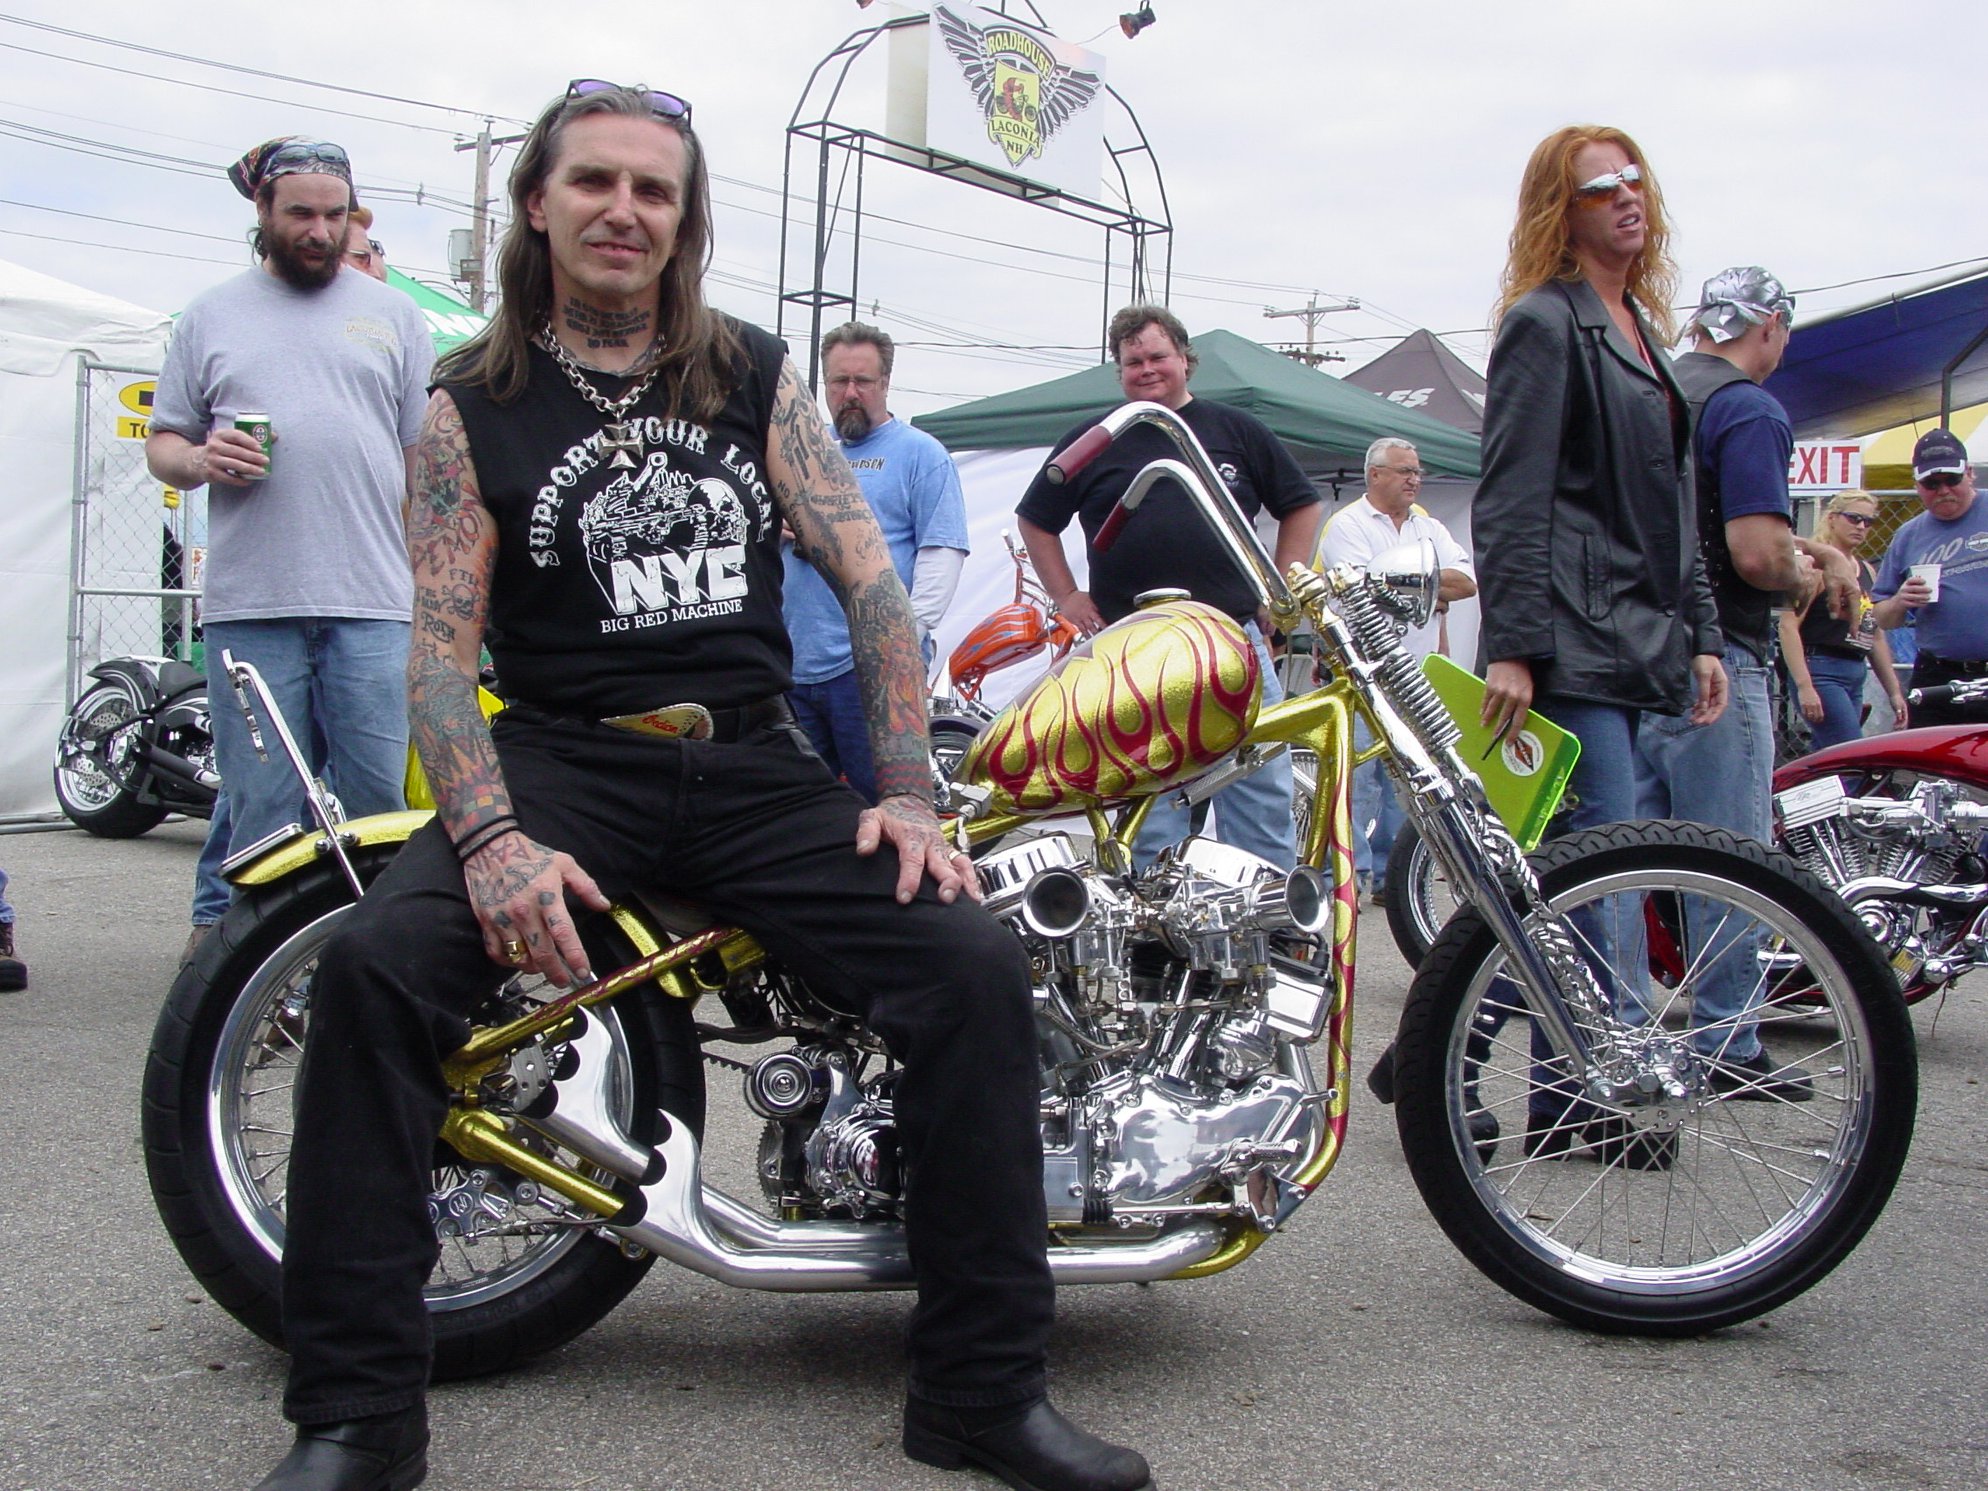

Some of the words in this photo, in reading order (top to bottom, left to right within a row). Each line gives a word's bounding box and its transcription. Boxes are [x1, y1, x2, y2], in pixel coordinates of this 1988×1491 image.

[987, 31, 1051, 77] ROADHOUSE
[991, 120, 1040, 148] LACONIA
[1006, 140, 1024, 155] NH
[529, 430, 607, 568] SUPPORT
[624, 416, 709, 455] YOUR
[720, 443, 773, 542] LOCAL
[610, 545, 748, 615] NYC
[600, 613, 629, 633] BIG
[634, 610, 668, 629] RED
[671, 599, 743, 622] MACHINE
